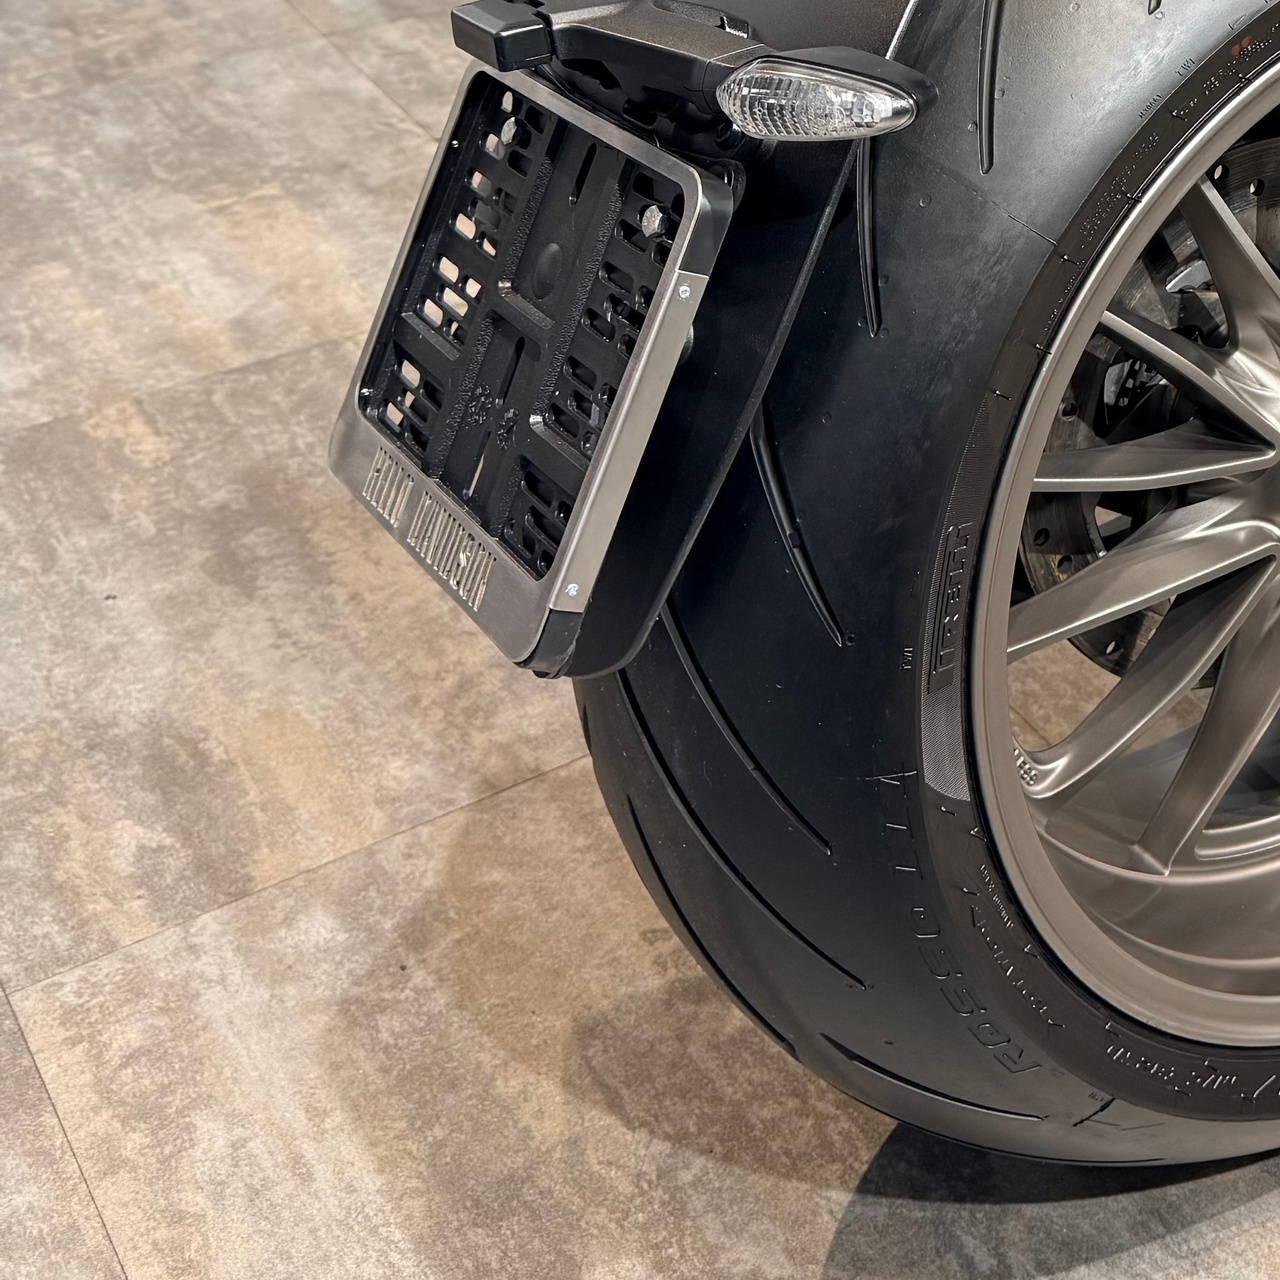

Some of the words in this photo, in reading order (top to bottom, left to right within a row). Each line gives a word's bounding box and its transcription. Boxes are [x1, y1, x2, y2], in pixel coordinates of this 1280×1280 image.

[407, 490, 497, 613] DAVIDSON
[933, 520, 974, 675] PIRELLI
[909, 905, 1042, 1075] ROSSO
